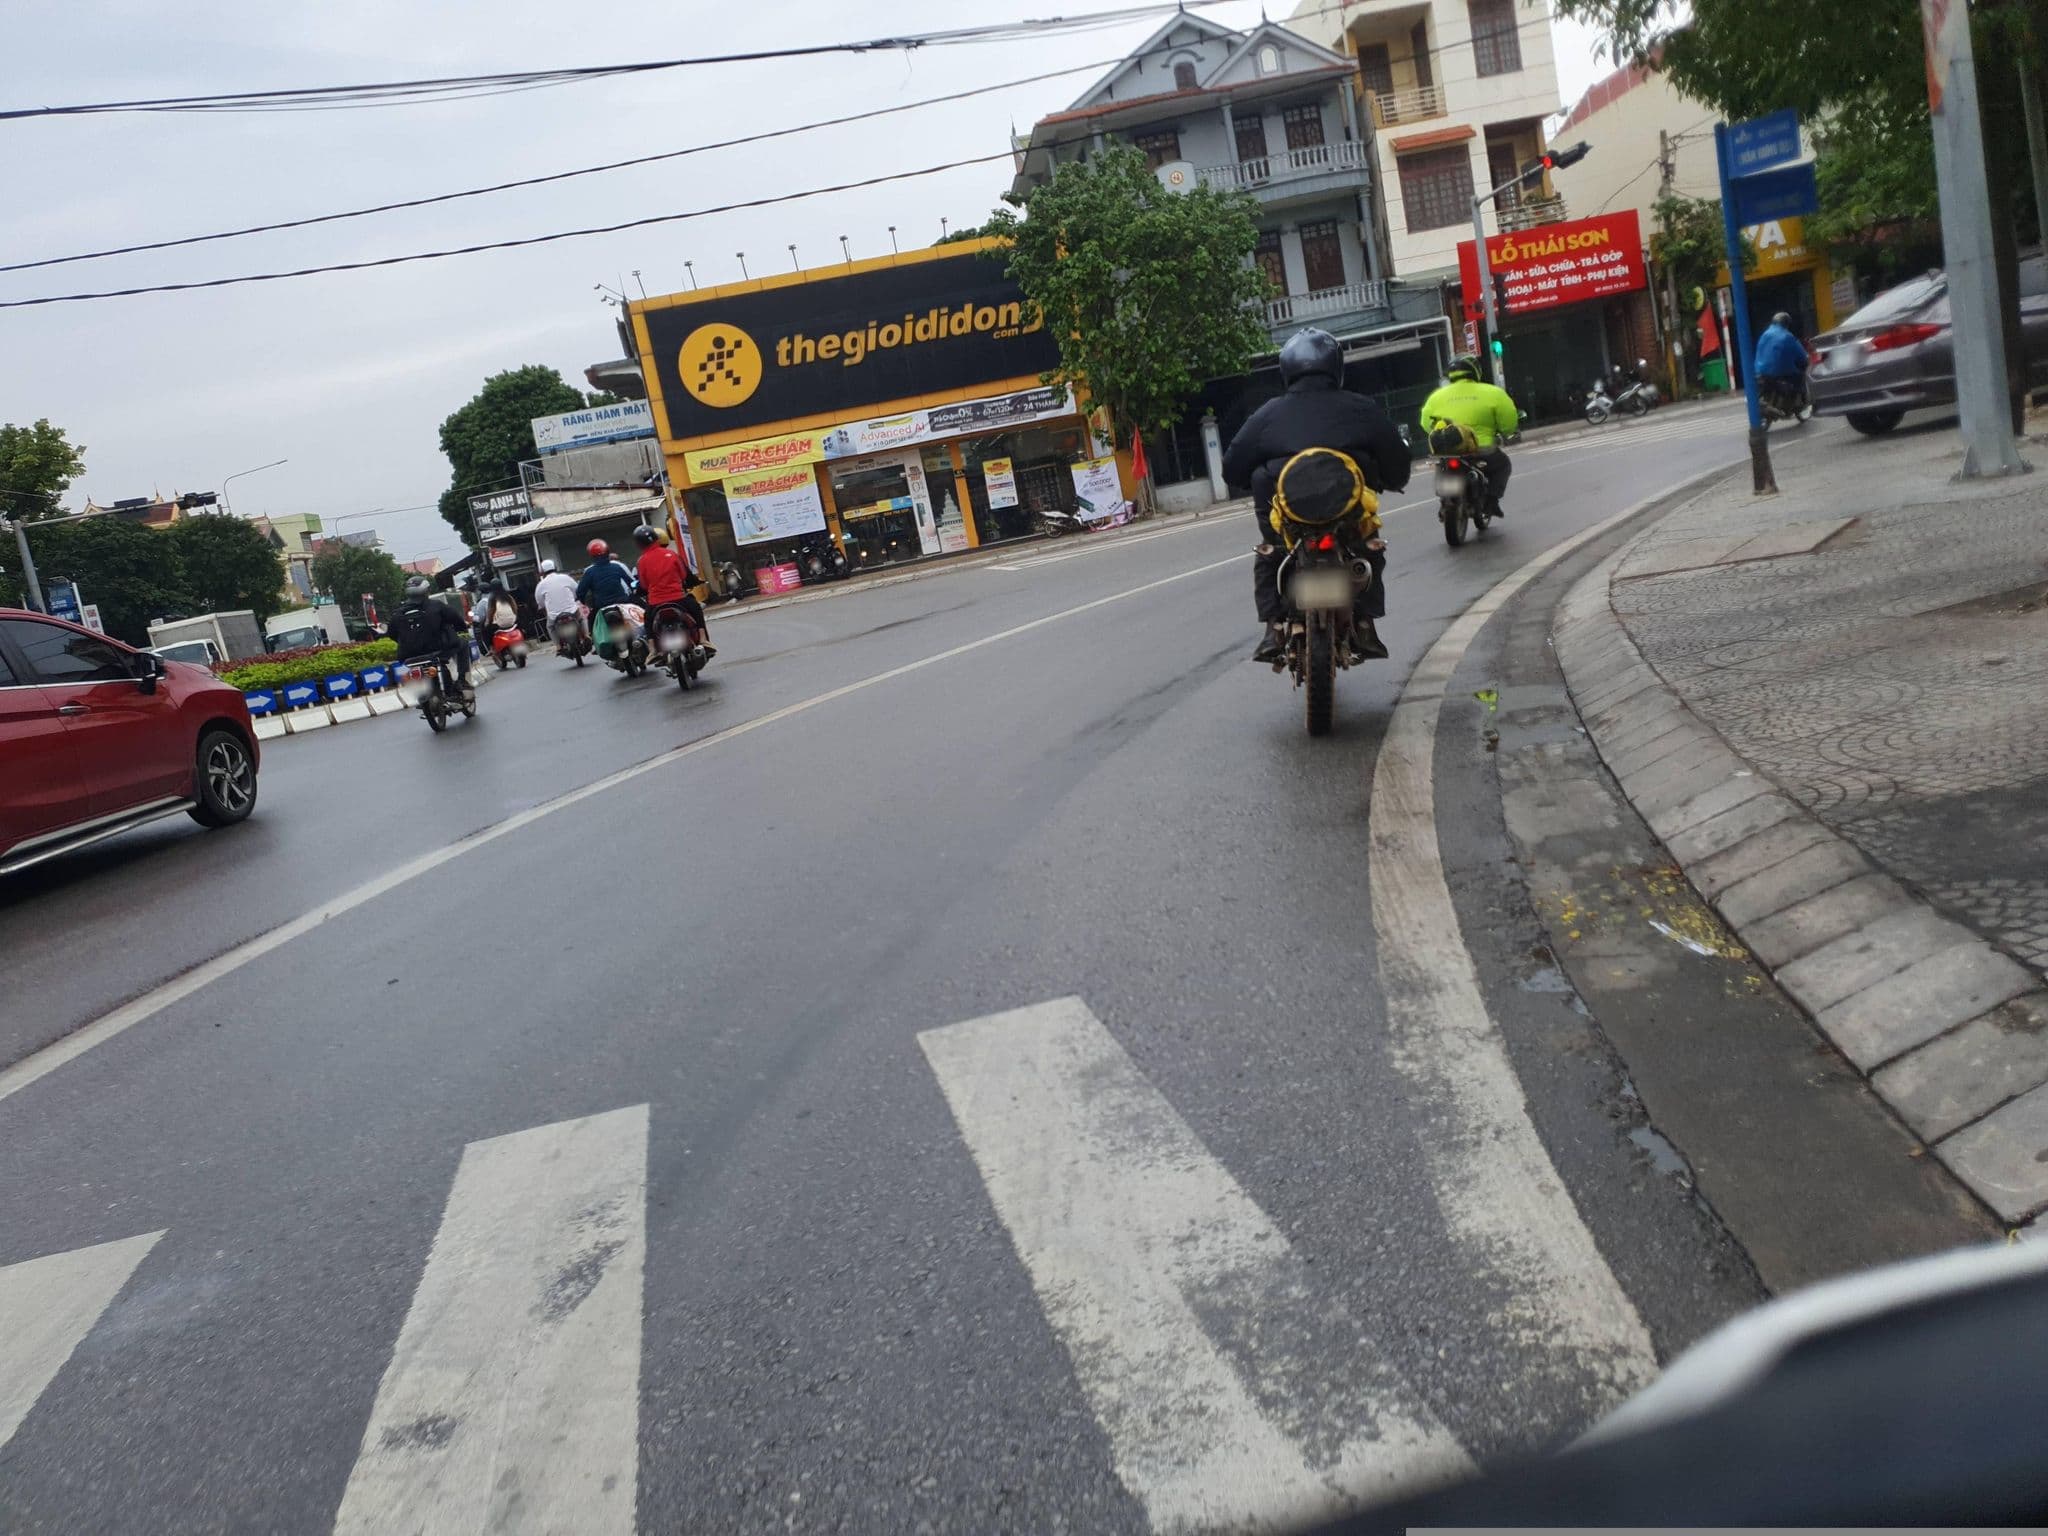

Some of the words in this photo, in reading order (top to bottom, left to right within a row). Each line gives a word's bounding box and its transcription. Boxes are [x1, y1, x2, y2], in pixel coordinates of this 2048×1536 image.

[1519, 233, 1565, 260] THÁI
[1567, 228, 1610, 250] SƠN
[1601, 250, 1623, 264] GÓP
[1504, 284, 1533, 298] HOẠI
[595, 406, 620, 421] HÀM
[860, 423, 912, 442] Advanced
[700, 455, 729, 470] MUA
[490, 494, 515, 510] ANH
